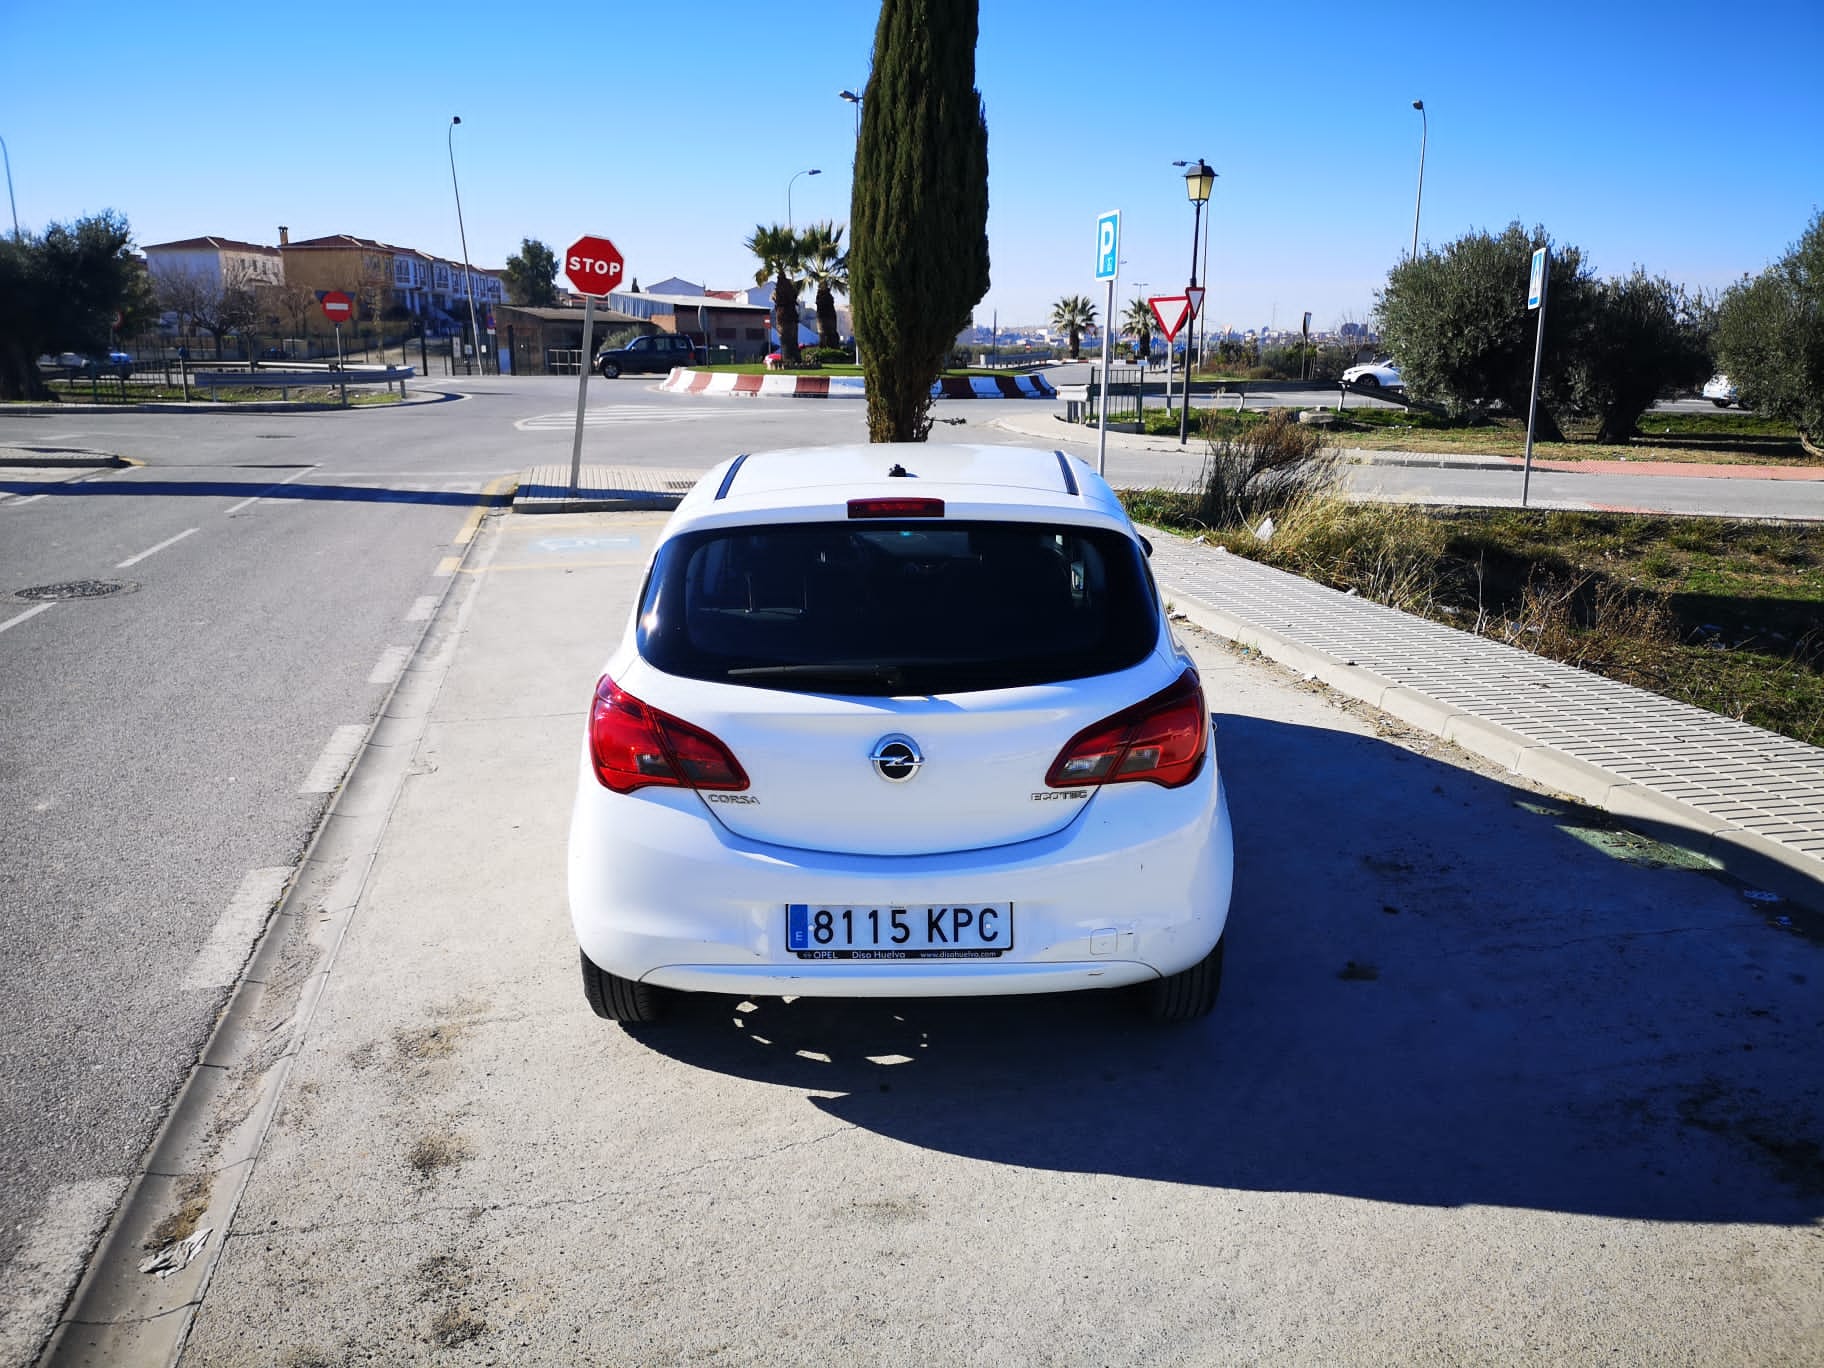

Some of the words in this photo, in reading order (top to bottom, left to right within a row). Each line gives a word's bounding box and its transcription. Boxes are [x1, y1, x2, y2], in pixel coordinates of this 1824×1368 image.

[1099, 221, 1114, 273] P
[569, 256, 621, 276] STOP
[708, 794, 761, 805] CORSA
[813, 909, 910, 944] 8115
[927, 907, 999, 943] KPC
[795, 931, 804, 942] E
[813, 951, 839, 960] OPEL
